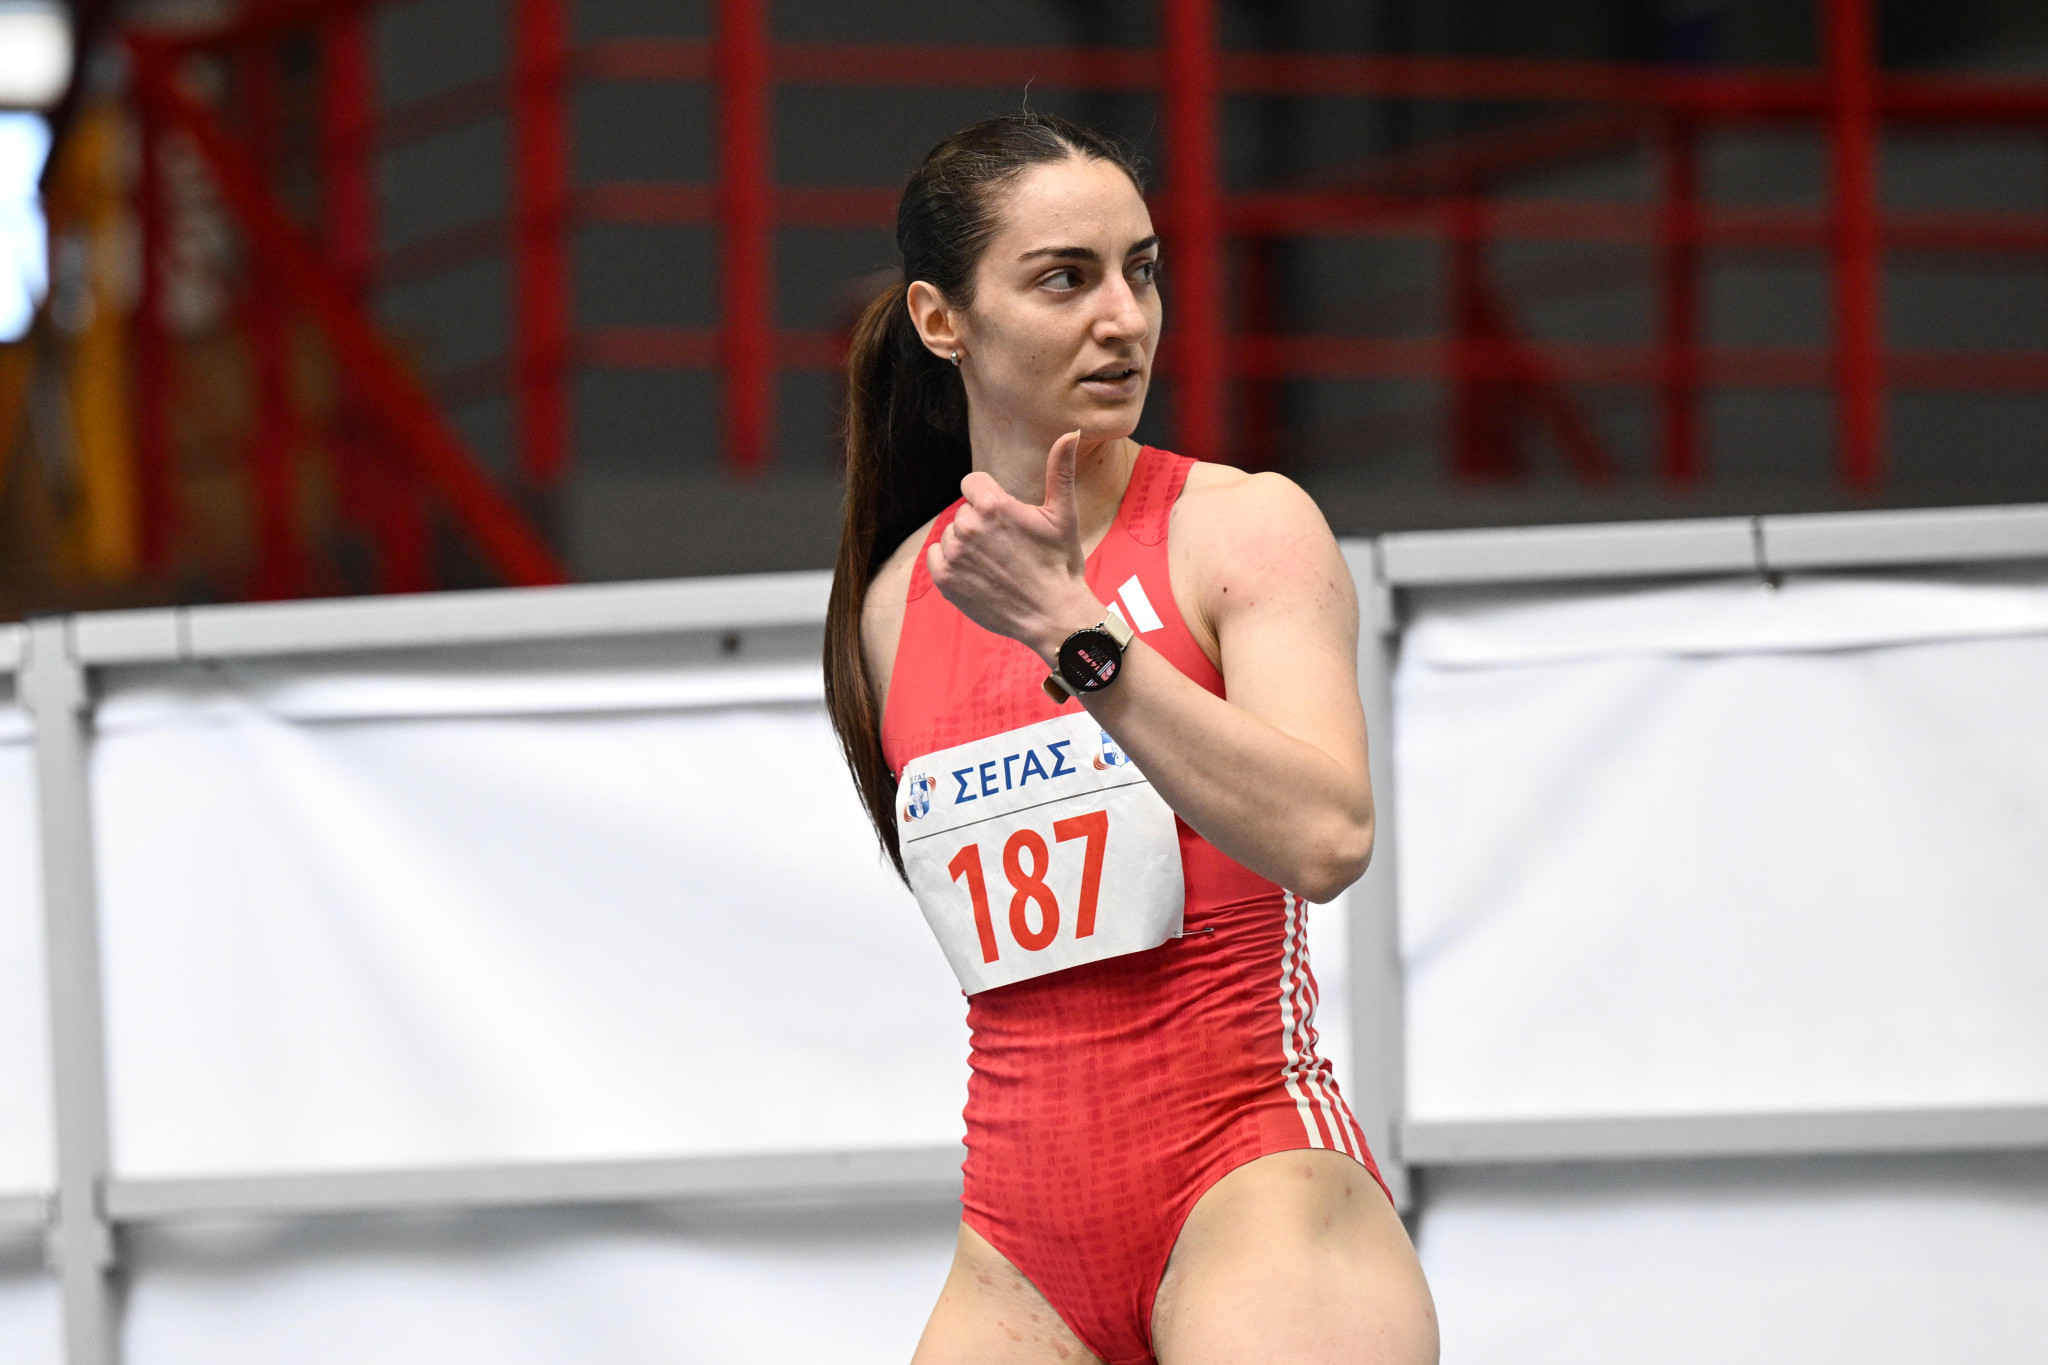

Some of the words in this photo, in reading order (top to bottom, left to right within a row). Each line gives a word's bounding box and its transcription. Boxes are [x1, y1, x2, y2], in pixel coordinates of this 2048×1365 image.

[1077, 649, 1093, 663] FEB
[910, 772, 927, 783] ΕΓΑΣ
[951, 740, 1077, 805] ΣΕΓΑΣ
[947, 809, 1109, 965] 187
